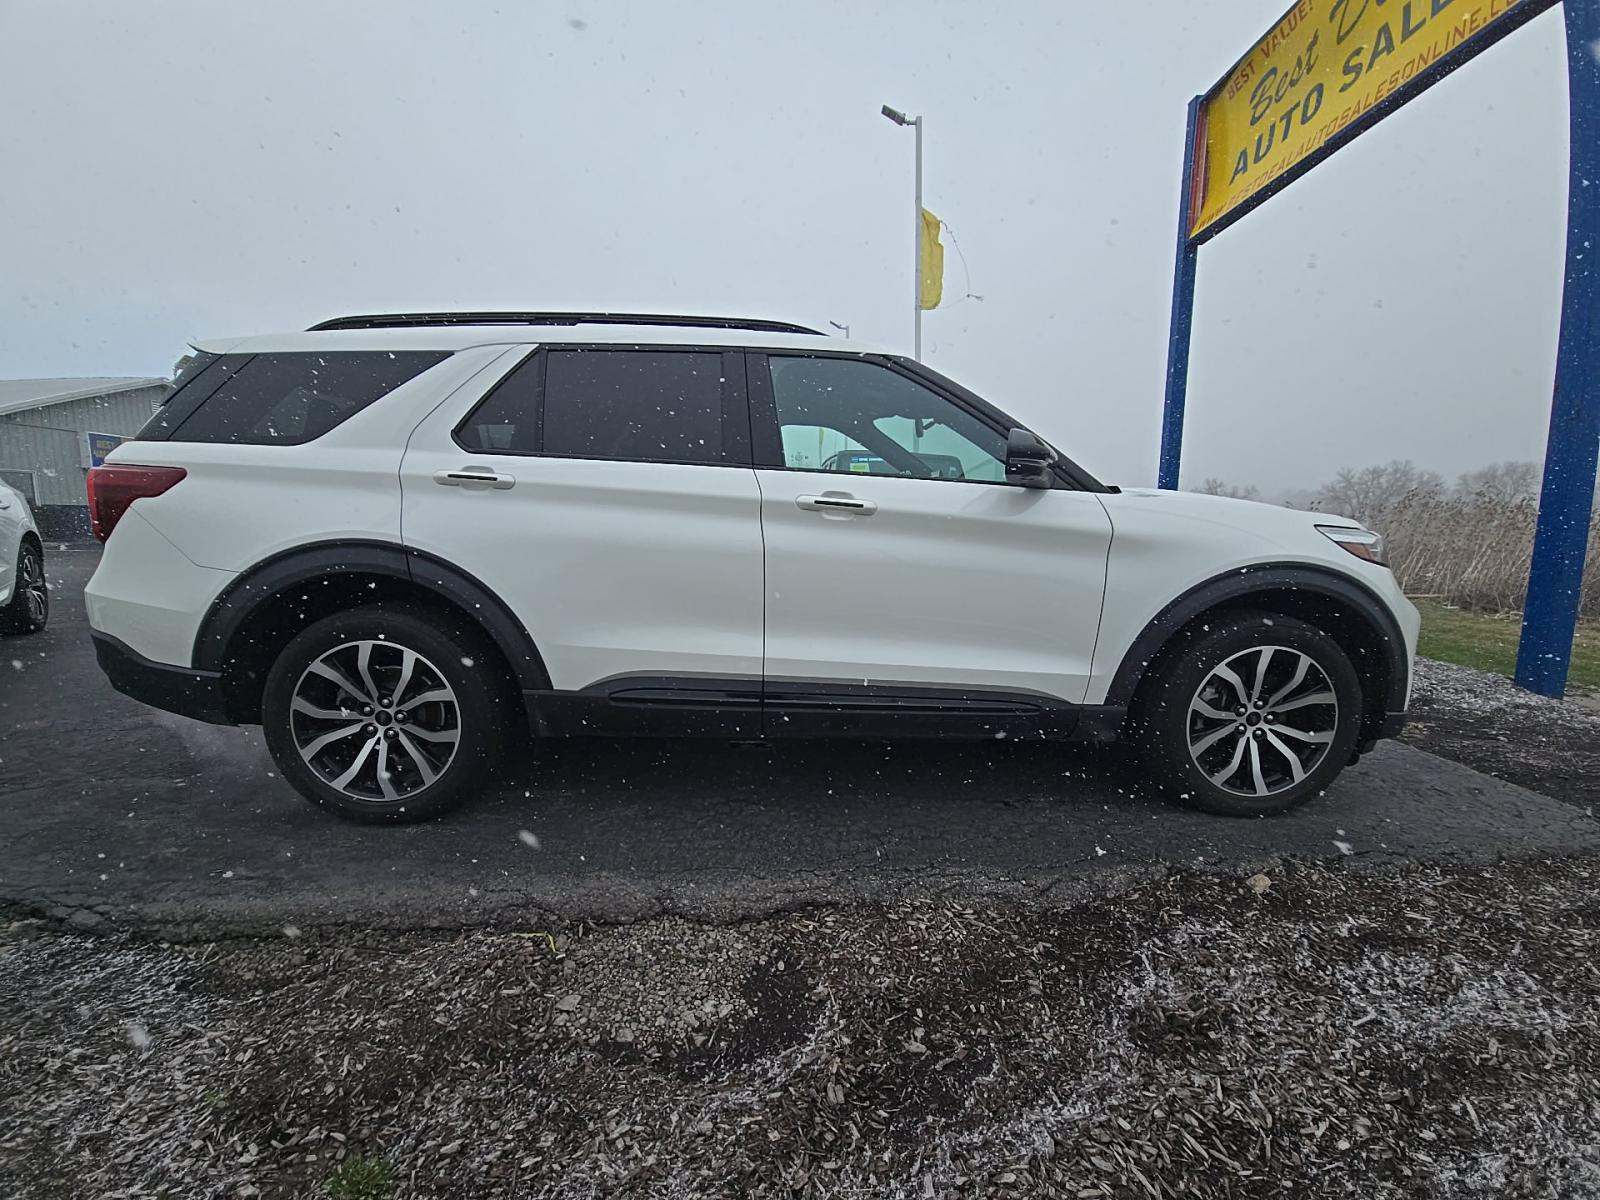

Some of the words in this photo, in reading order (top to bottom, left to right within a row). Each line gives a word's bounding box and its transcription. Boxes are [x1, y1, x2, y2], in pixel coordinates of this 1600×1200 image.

[1227, 59, 1255, 99] BEST
[1249, 27, 1320, 126] Best
[1229, 82, 1325, 186] AUTO
